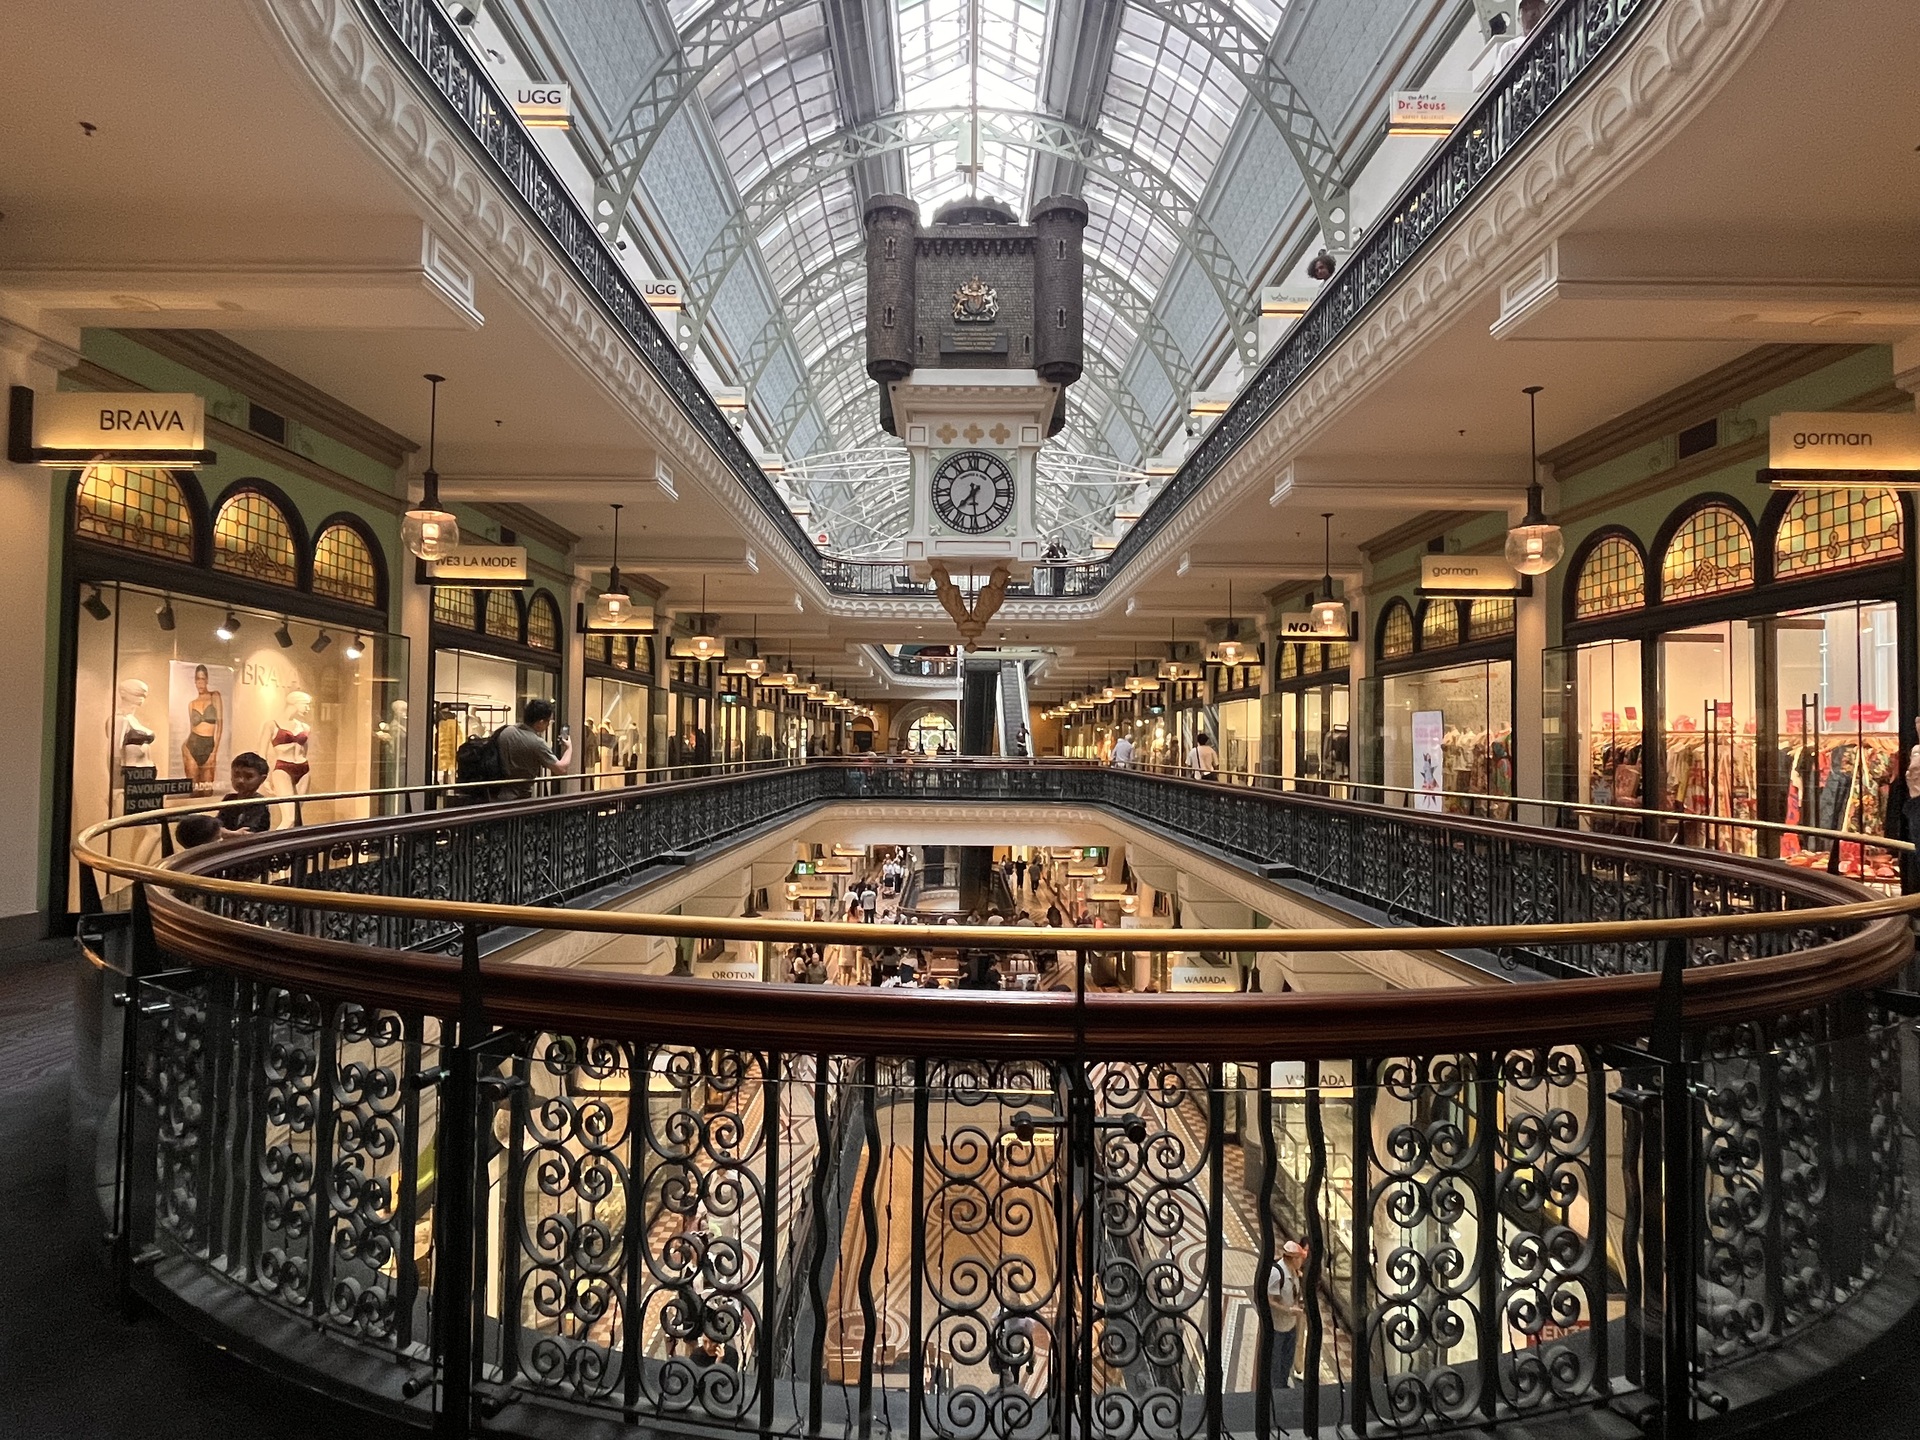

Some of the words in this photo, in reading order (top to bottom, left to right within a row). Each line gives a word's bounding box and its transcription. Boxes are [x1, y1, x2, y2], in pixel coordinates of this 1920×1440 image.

[518, 89, 561, 104] UGG
[1398, 100, 1413, 110] Dr.
[1417, 100, 1446, 110] Seuss
[645, 284, 677, 295] UGG
[100, 409, 184, 431] BRAVA
[1793, 432, 1872, 449] gorman
[463, 556, 478, 567] LA
[481, 557, 517, 568] MODE
[1432, 567, 1478, 577] gorman
[127, 769, 153, 780] YOUR
[127, 782, 175, 795] FAVOURITE
[178, 781, 191, 792] FIT
[127, 801, 136, 810] IS
[138, 798, 161, 808] ONLY
[712, 971, 755, 979] OROTON
[1184, 976, 1226, 984] WAMADA
